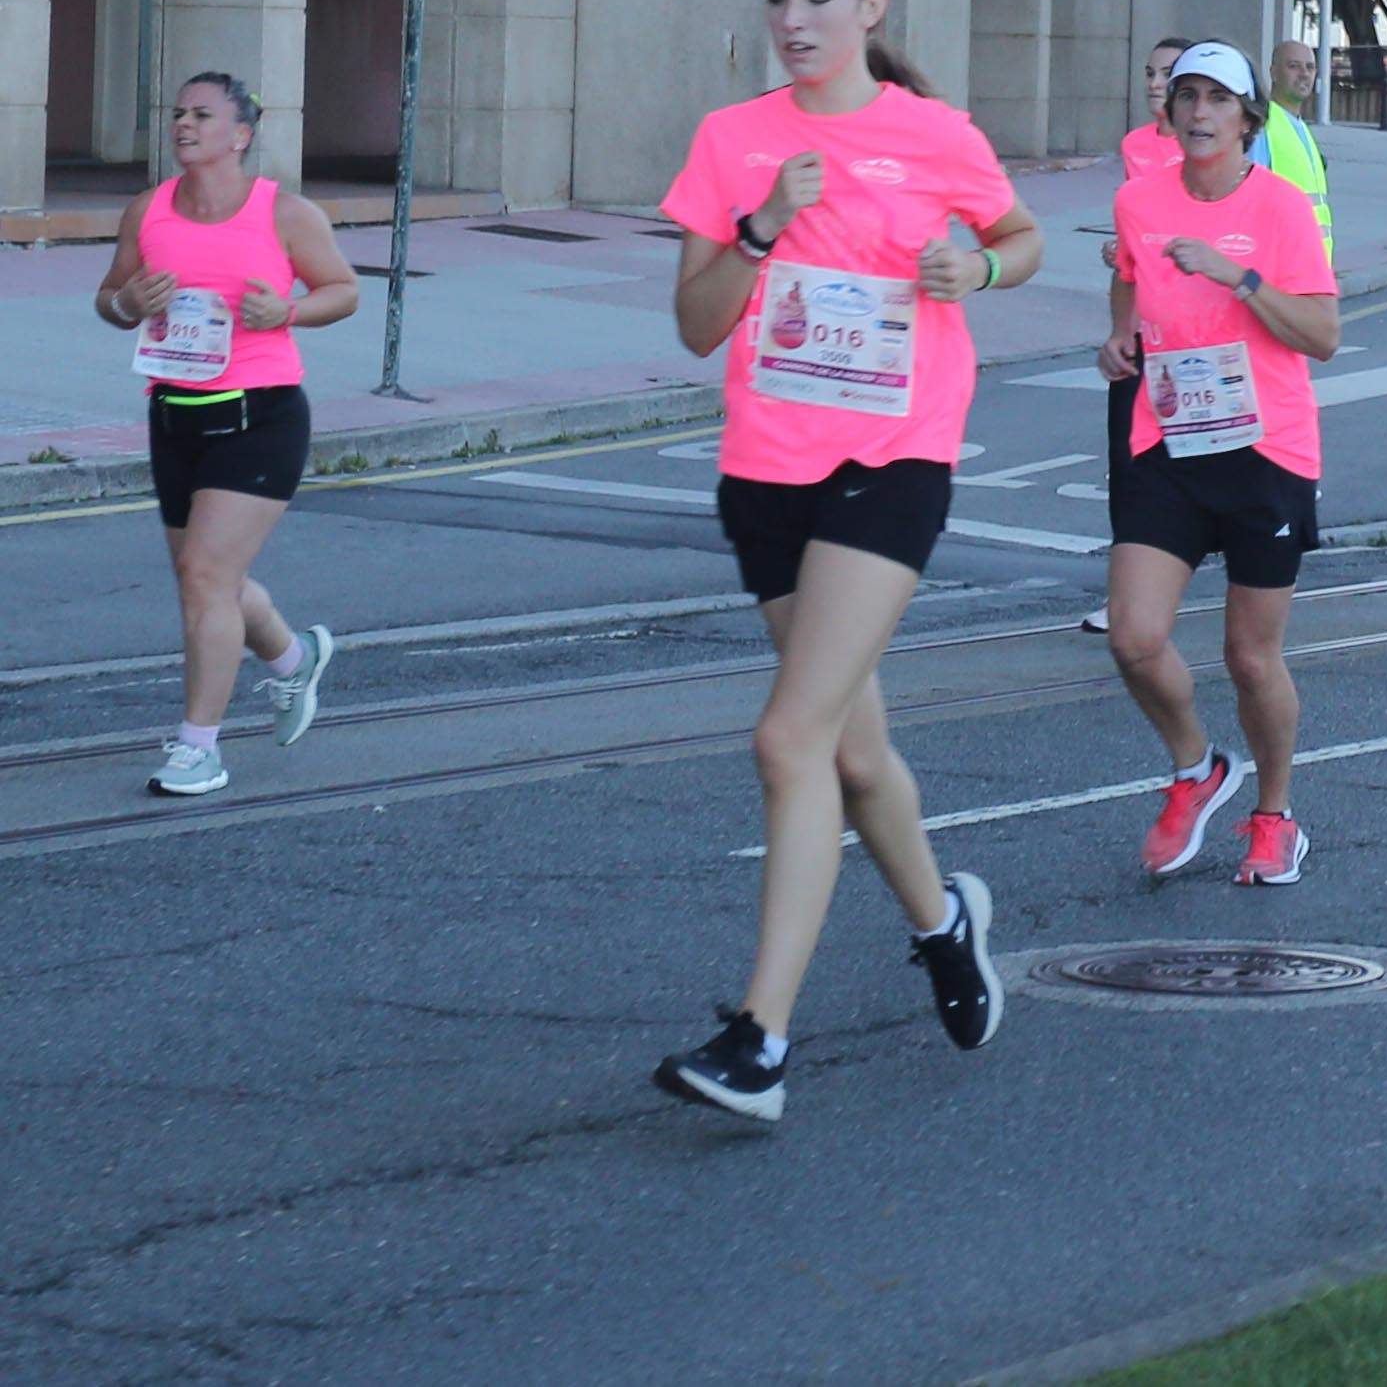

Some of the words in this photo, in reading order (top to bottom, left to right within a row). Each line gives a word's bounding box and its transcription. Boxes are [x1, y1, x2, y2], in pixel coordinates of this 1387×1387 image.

[171, 323, 200, 339] 016
[813, 323, 865, 349] 016
[1182, 389, 1215, 407] 016
